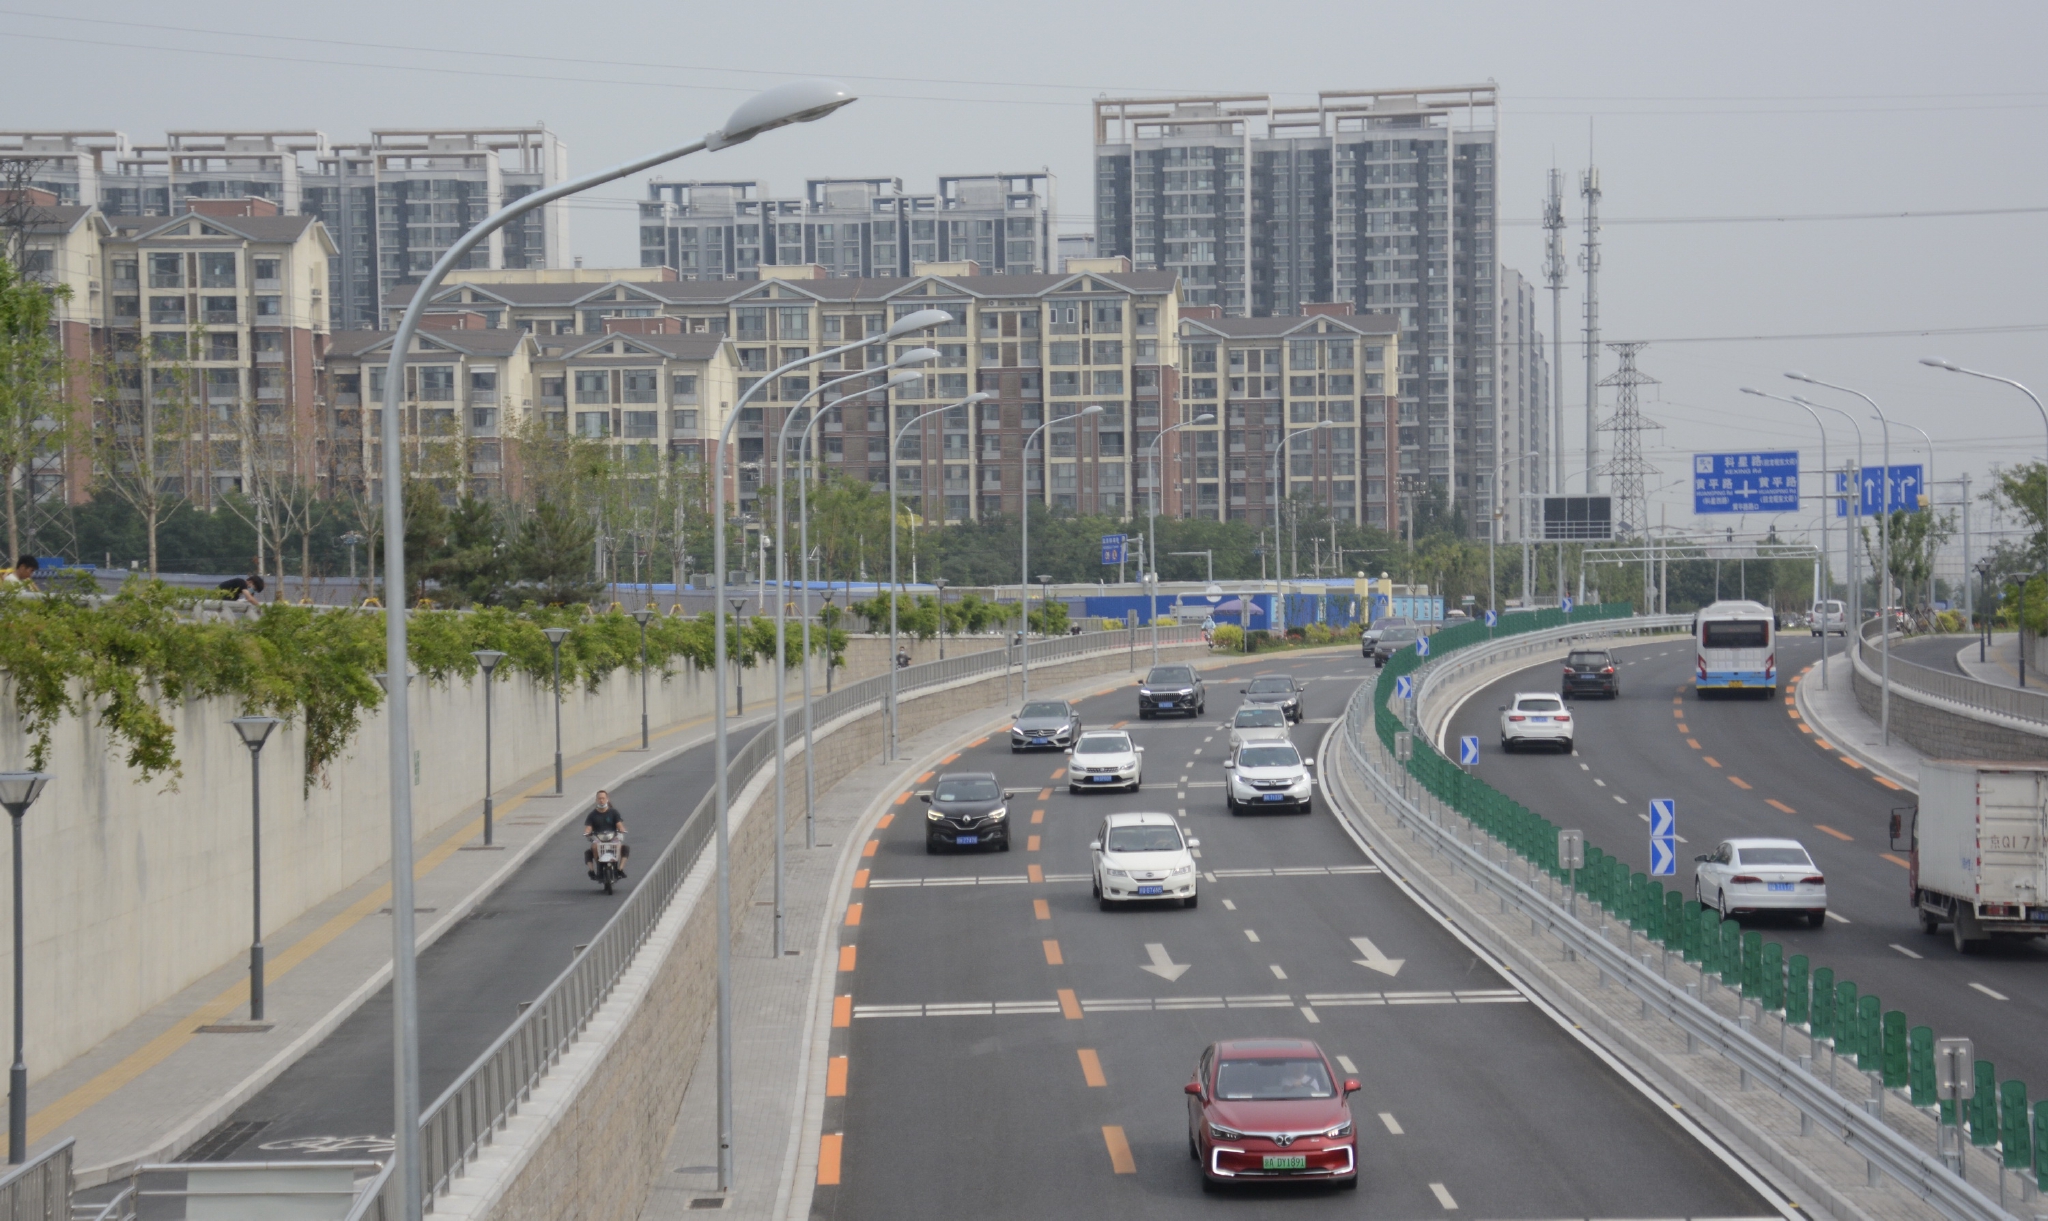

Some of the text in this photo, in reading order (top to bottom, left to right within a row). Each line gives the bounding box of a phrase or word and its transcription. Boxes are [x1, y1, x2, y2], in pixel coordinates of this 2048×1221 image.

[1724, 455, 1761, 467] 科星路
[1696, 478, 1733, 490] 黄平路
[1758, 475, 1797, 488] 黄平路
